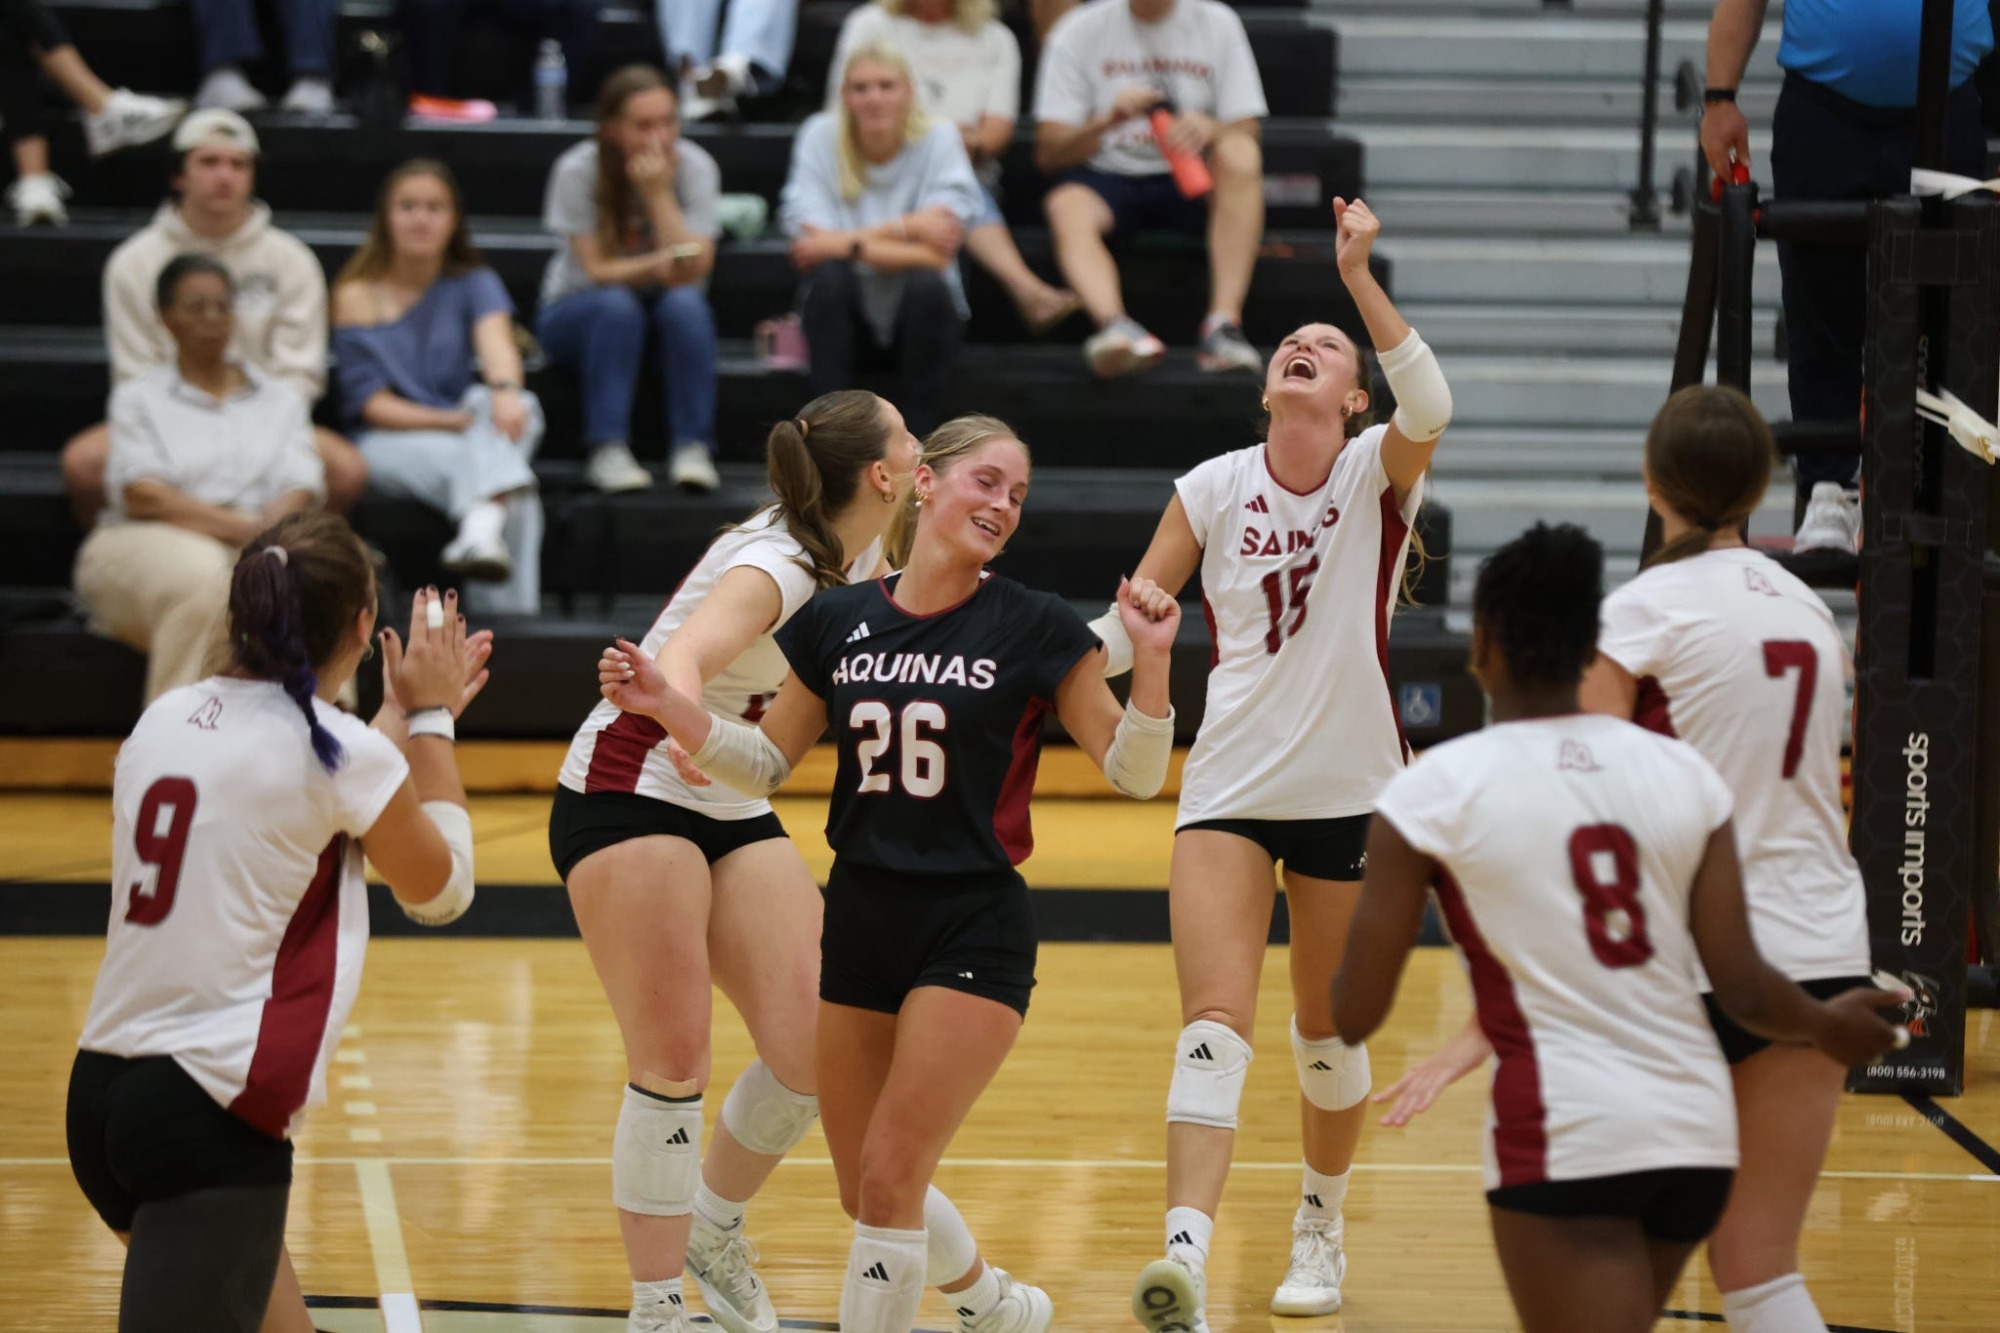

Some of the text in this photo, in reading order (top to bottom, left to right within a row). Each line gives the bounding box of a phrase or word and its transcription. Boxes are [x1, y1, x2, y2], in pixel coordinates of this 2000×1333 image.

[1240, 506, 1340, 557] SAINS
[1262, 552, 1319, 655] 15
[832, 652, 998, 690] AQUINAS
[1762, 640, 1818, 780] 7
[850, 701, 946, 798] 26
[124, 775, 198, 927] 9
[1897, 731, 1931, 947] sports imports
[1568, 822, 1655, 969] 8
[1866, 1064, 1946, 1080] (800) 556-3198
